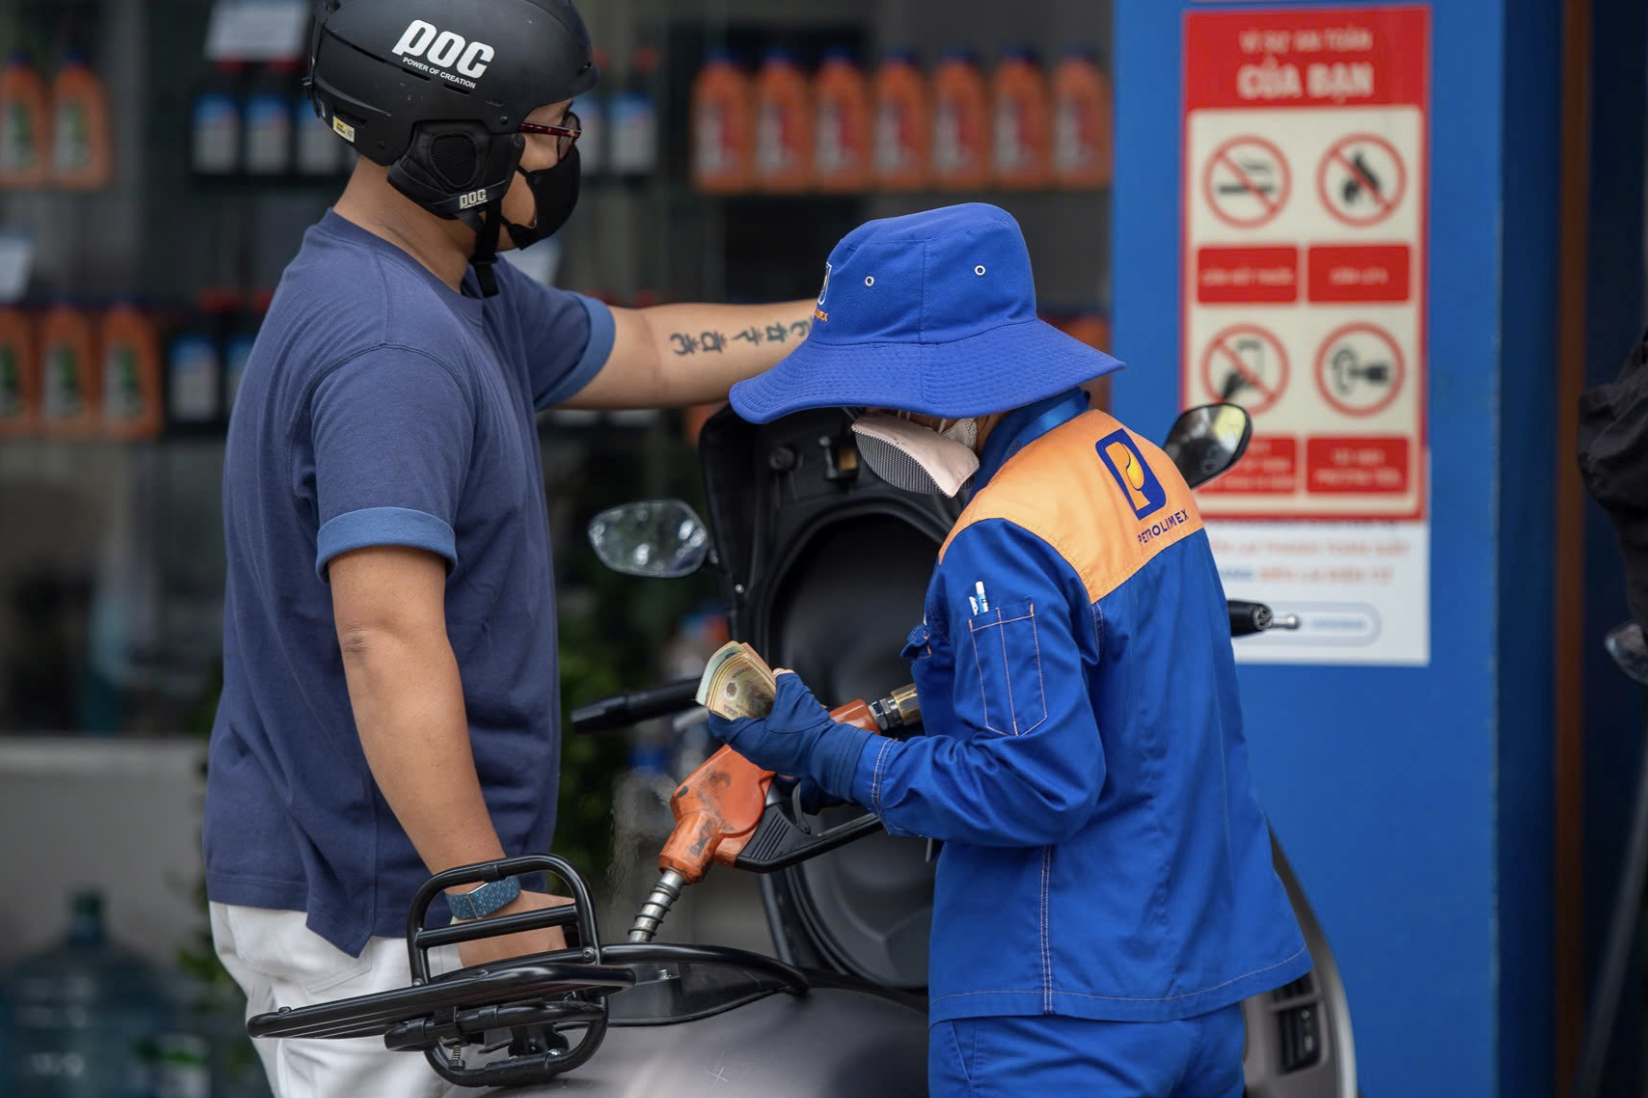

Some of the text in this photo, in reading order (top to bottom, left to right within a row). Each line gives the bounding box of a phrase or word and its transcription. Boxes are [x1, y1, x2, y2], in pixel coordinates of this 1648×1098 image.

[391, 19, 495, 79] POC
[402, 56, 477, 89] POWER OF CREATION
[1237, 55, 1374, 103] CỦA BẠN
[459, 188, 487, 209] POC
[1137, 509, 1190, 545] PETROLIMEX
